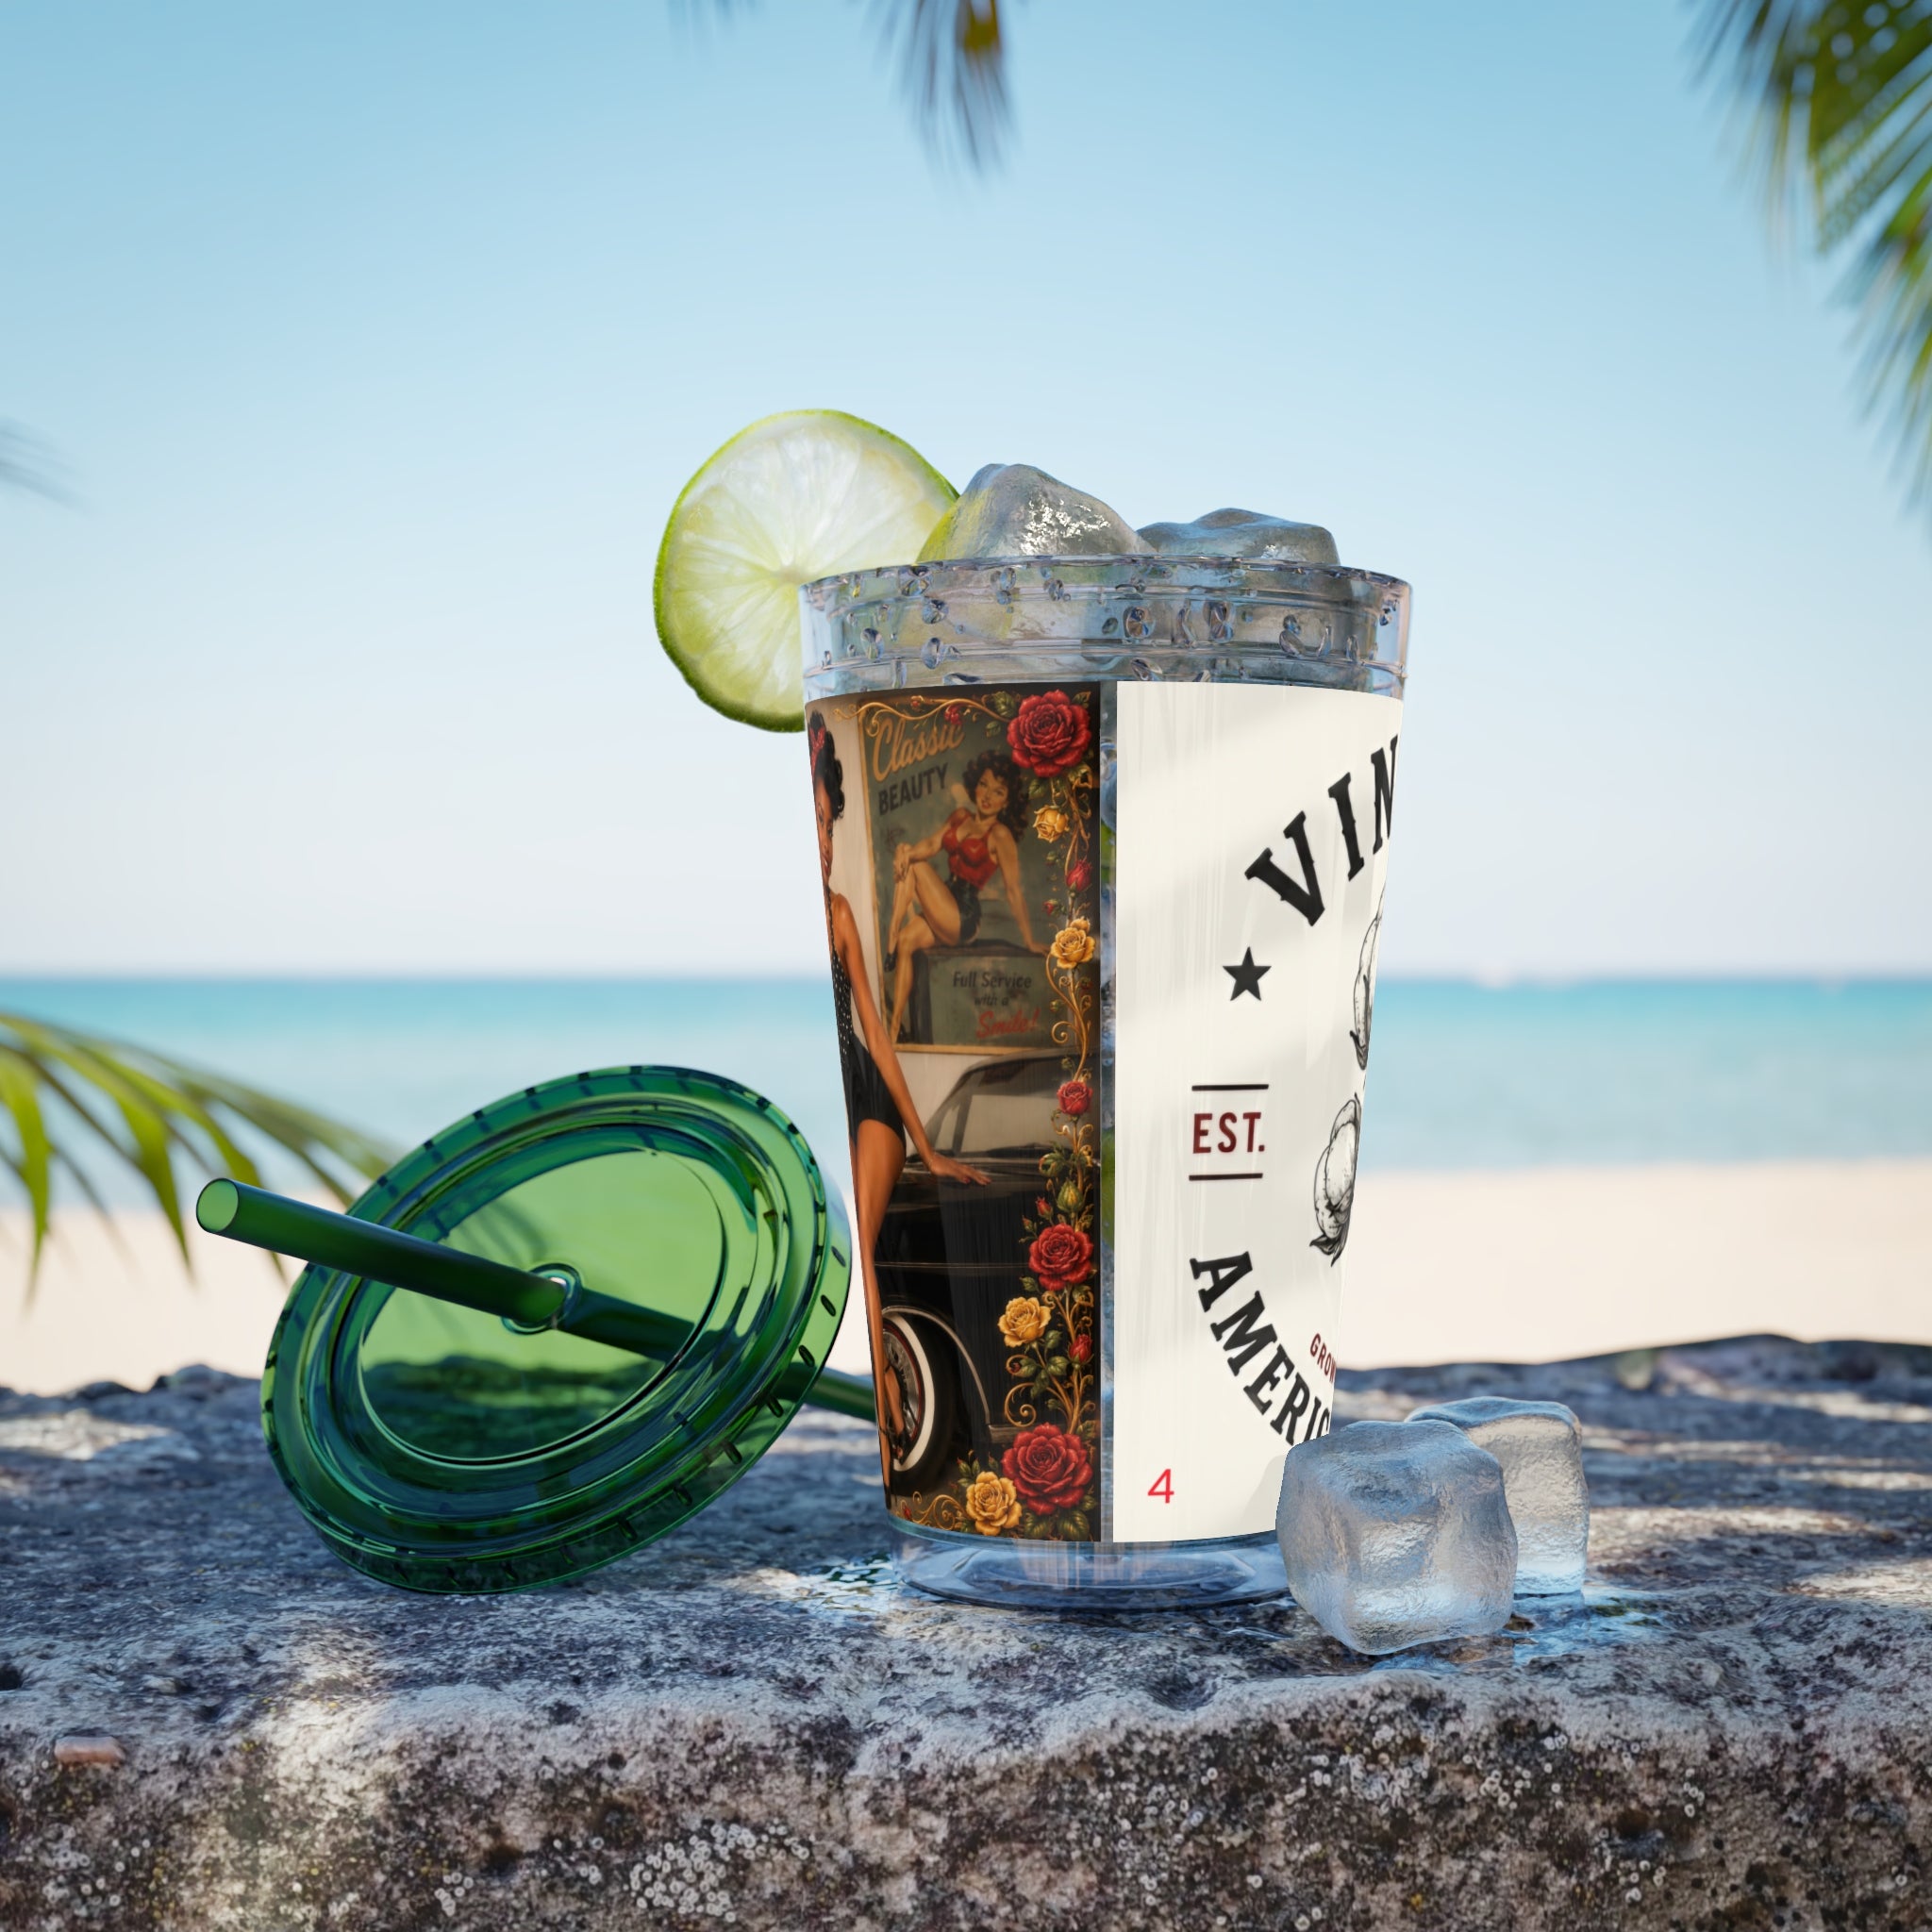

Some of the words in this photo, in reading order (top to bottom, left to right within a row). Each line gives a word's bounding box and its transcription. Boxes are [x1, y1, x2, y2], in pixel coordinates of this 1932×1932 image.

[873, 718, 965, 782] Classic
[878, 762, 947, 816] BEAUTY
[953, 971, 977, 988] Full
[981, 971, 1032, 989] Service
[974, 993, 997, 1007] with
[1001, 996, 1009, 1007] a
[1192, 1112, 1266, 1154] EST.
[1147, 1469, 1174, 1504] 4
